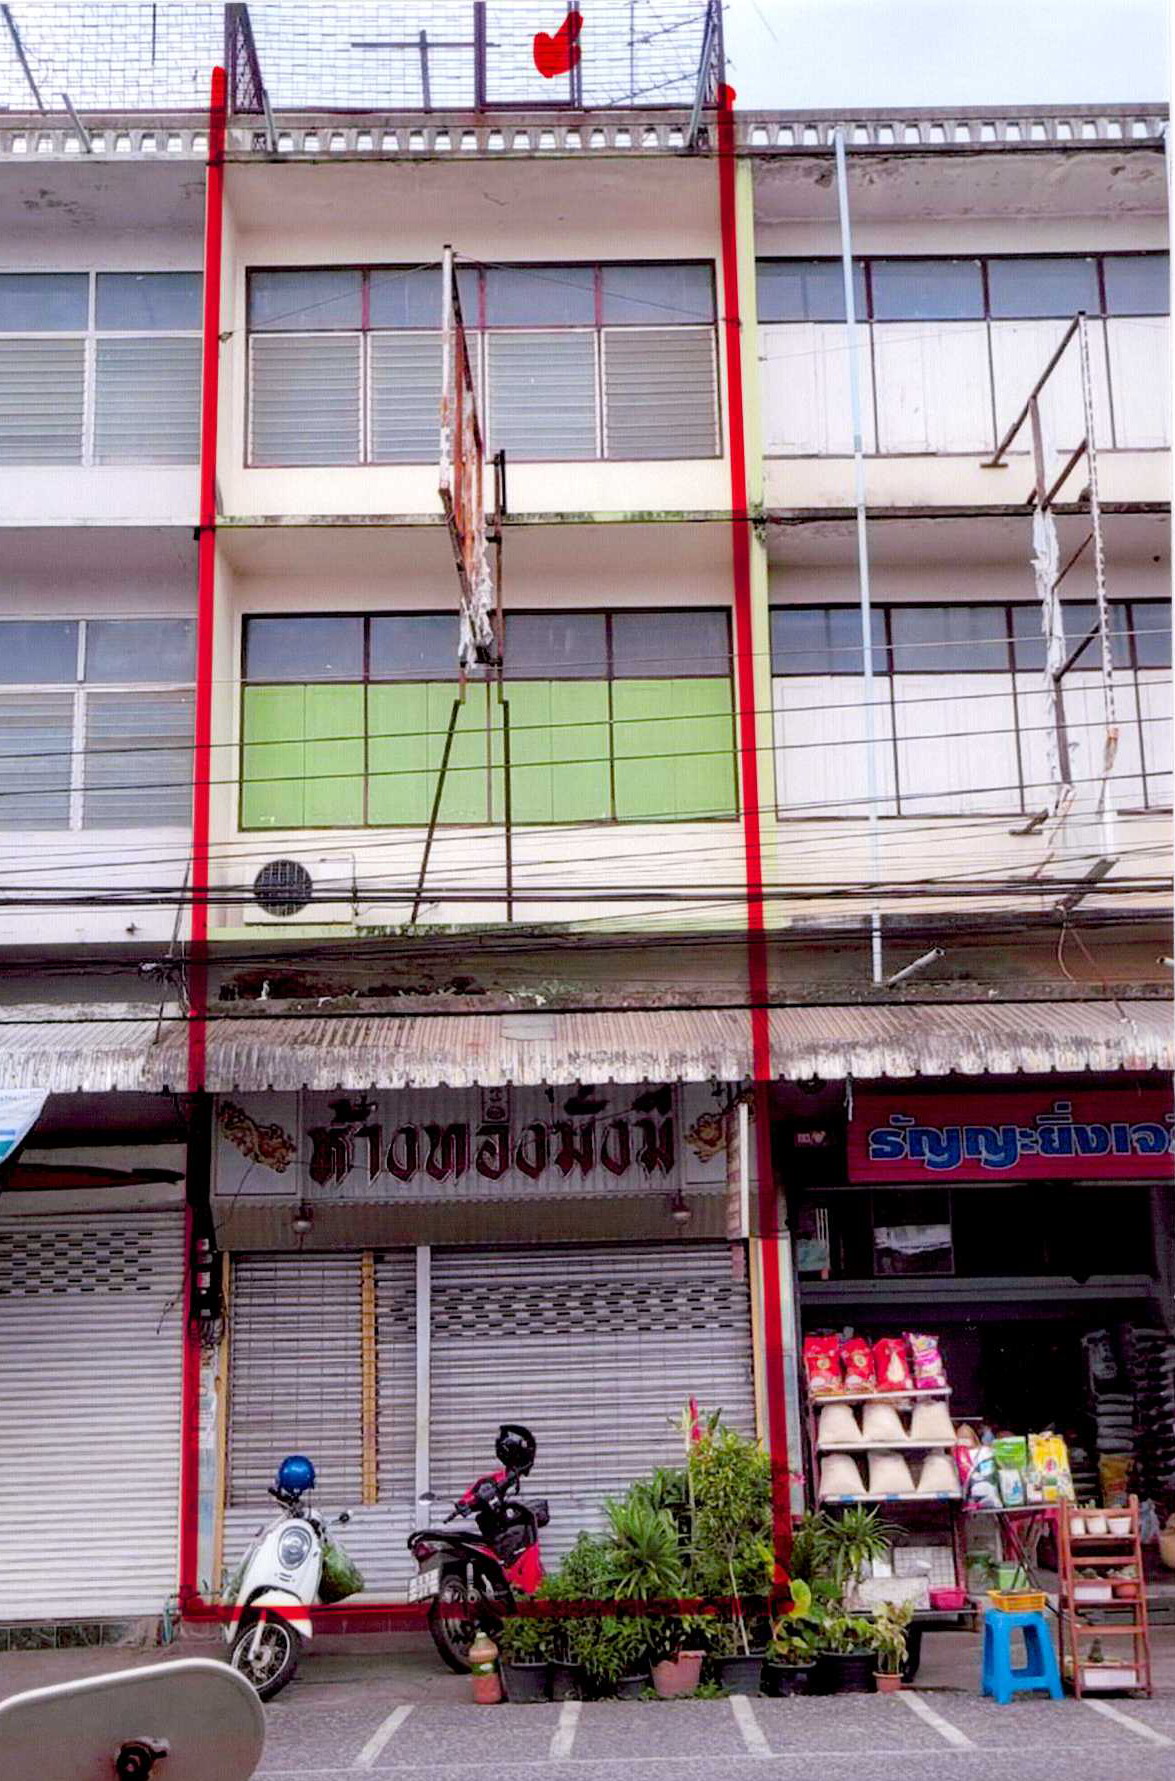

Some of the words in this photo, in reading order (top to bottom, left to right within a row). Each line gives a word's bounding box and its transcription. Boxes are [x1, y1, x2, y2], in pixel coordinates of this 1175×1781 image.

[868, 1101, 1174, 1171] ธัญญะยิ่งเจ
